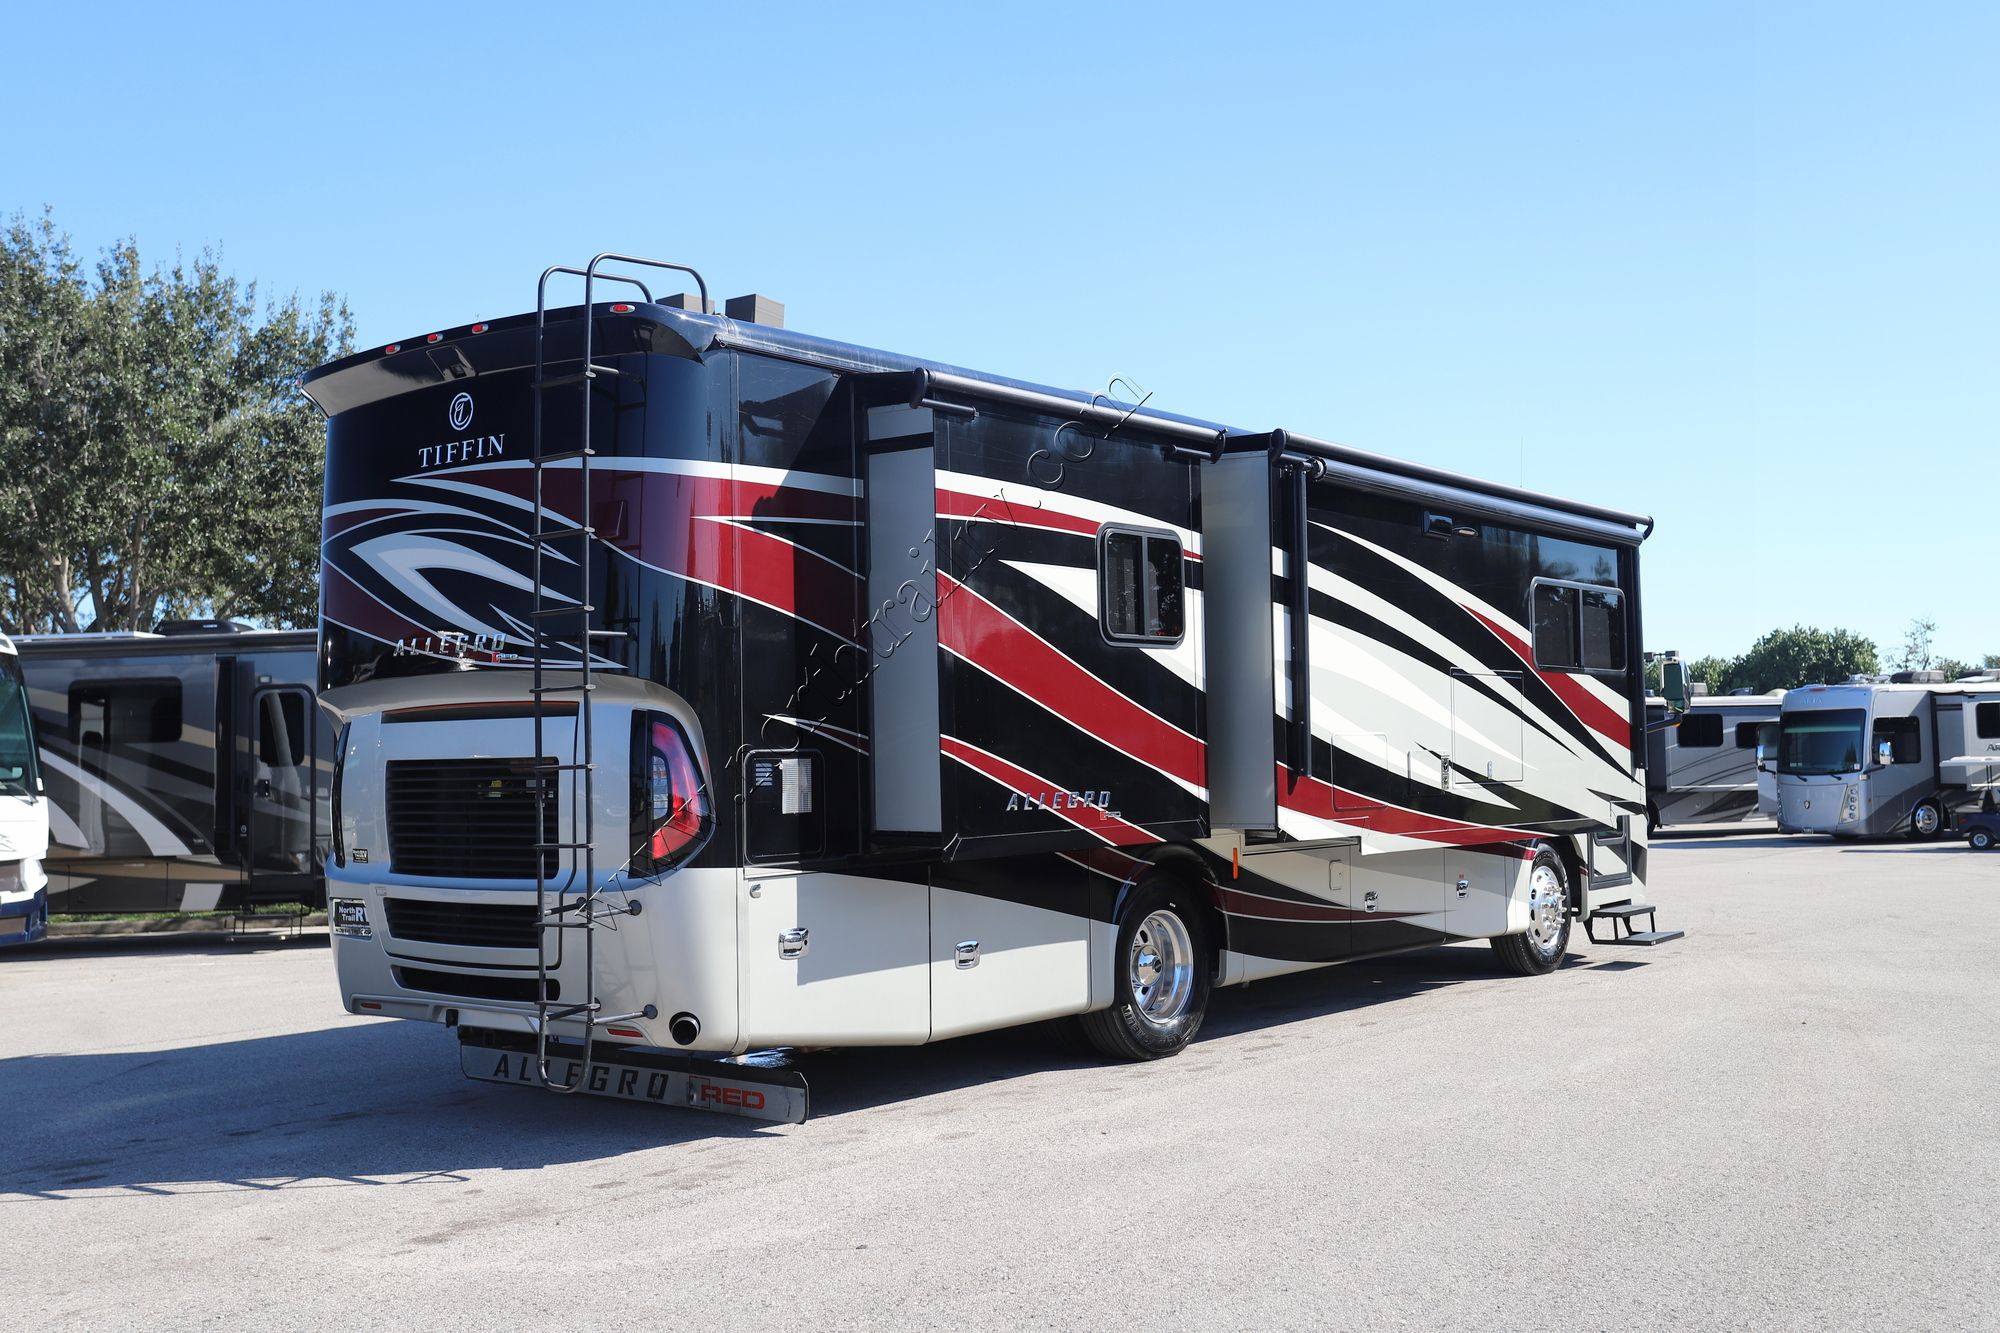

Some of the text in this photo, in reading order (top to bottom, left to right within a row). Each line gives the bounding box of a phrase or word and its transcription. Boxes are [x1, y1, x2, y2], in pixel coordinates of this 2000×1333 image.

[418, 433, 505, 468] TIFFIN
[392, 632, 507, 657] ALLEGRO
[1006, 791, 1111, 811] ALLEGRO
[338, 906, 355, 914] North
[341, 914, 355, 922] Trail
[701, 1084, 765, 1110] RED
